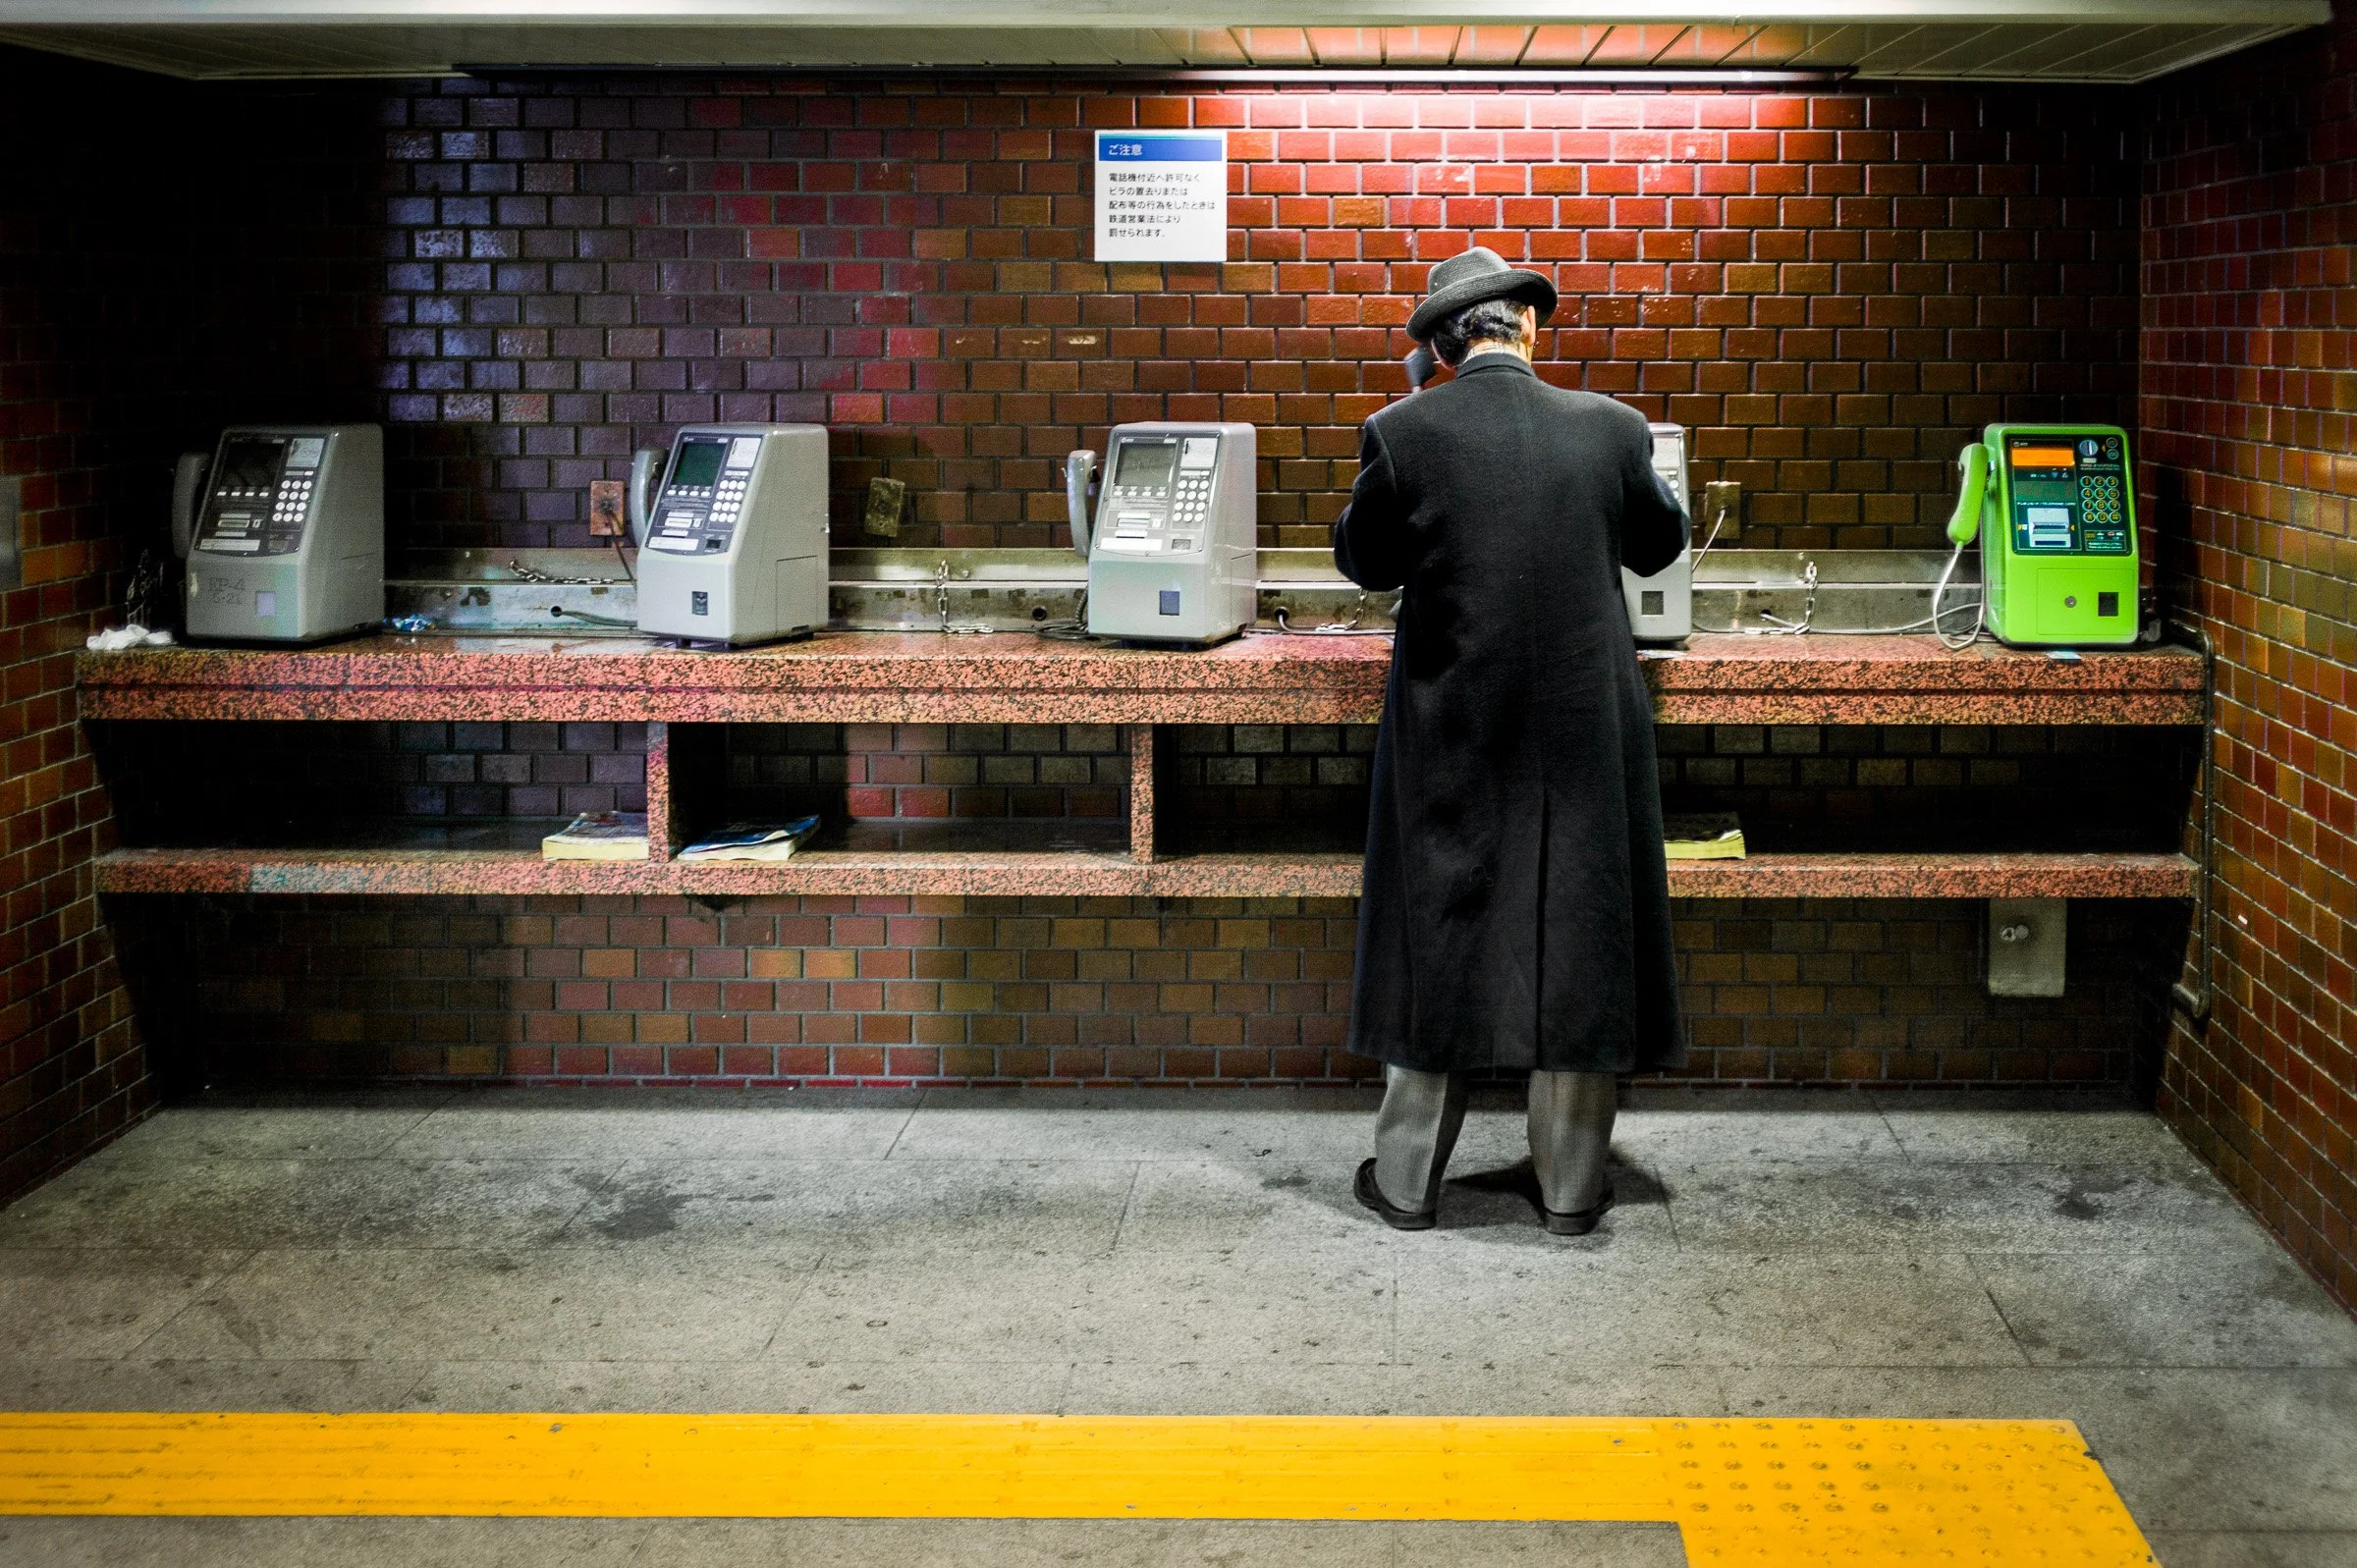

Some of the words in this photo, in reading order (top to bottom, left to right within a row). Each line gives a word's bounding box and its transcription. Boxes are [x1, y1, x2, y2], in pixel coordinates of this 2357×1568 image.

[1108, 143, 1143, 156] ご注意
[1109, 173, 1201, 183] 電話機付近へ許可なく
[1109, 187, 1188, 196] ビラの置去りまたは
[1109, 200, 1216, 210] 配布等の行為をしたときは
[1109, 214, 1181, 224] 鉄道営業法により
[1109, 228, 1166, 238] 罰せられます。
